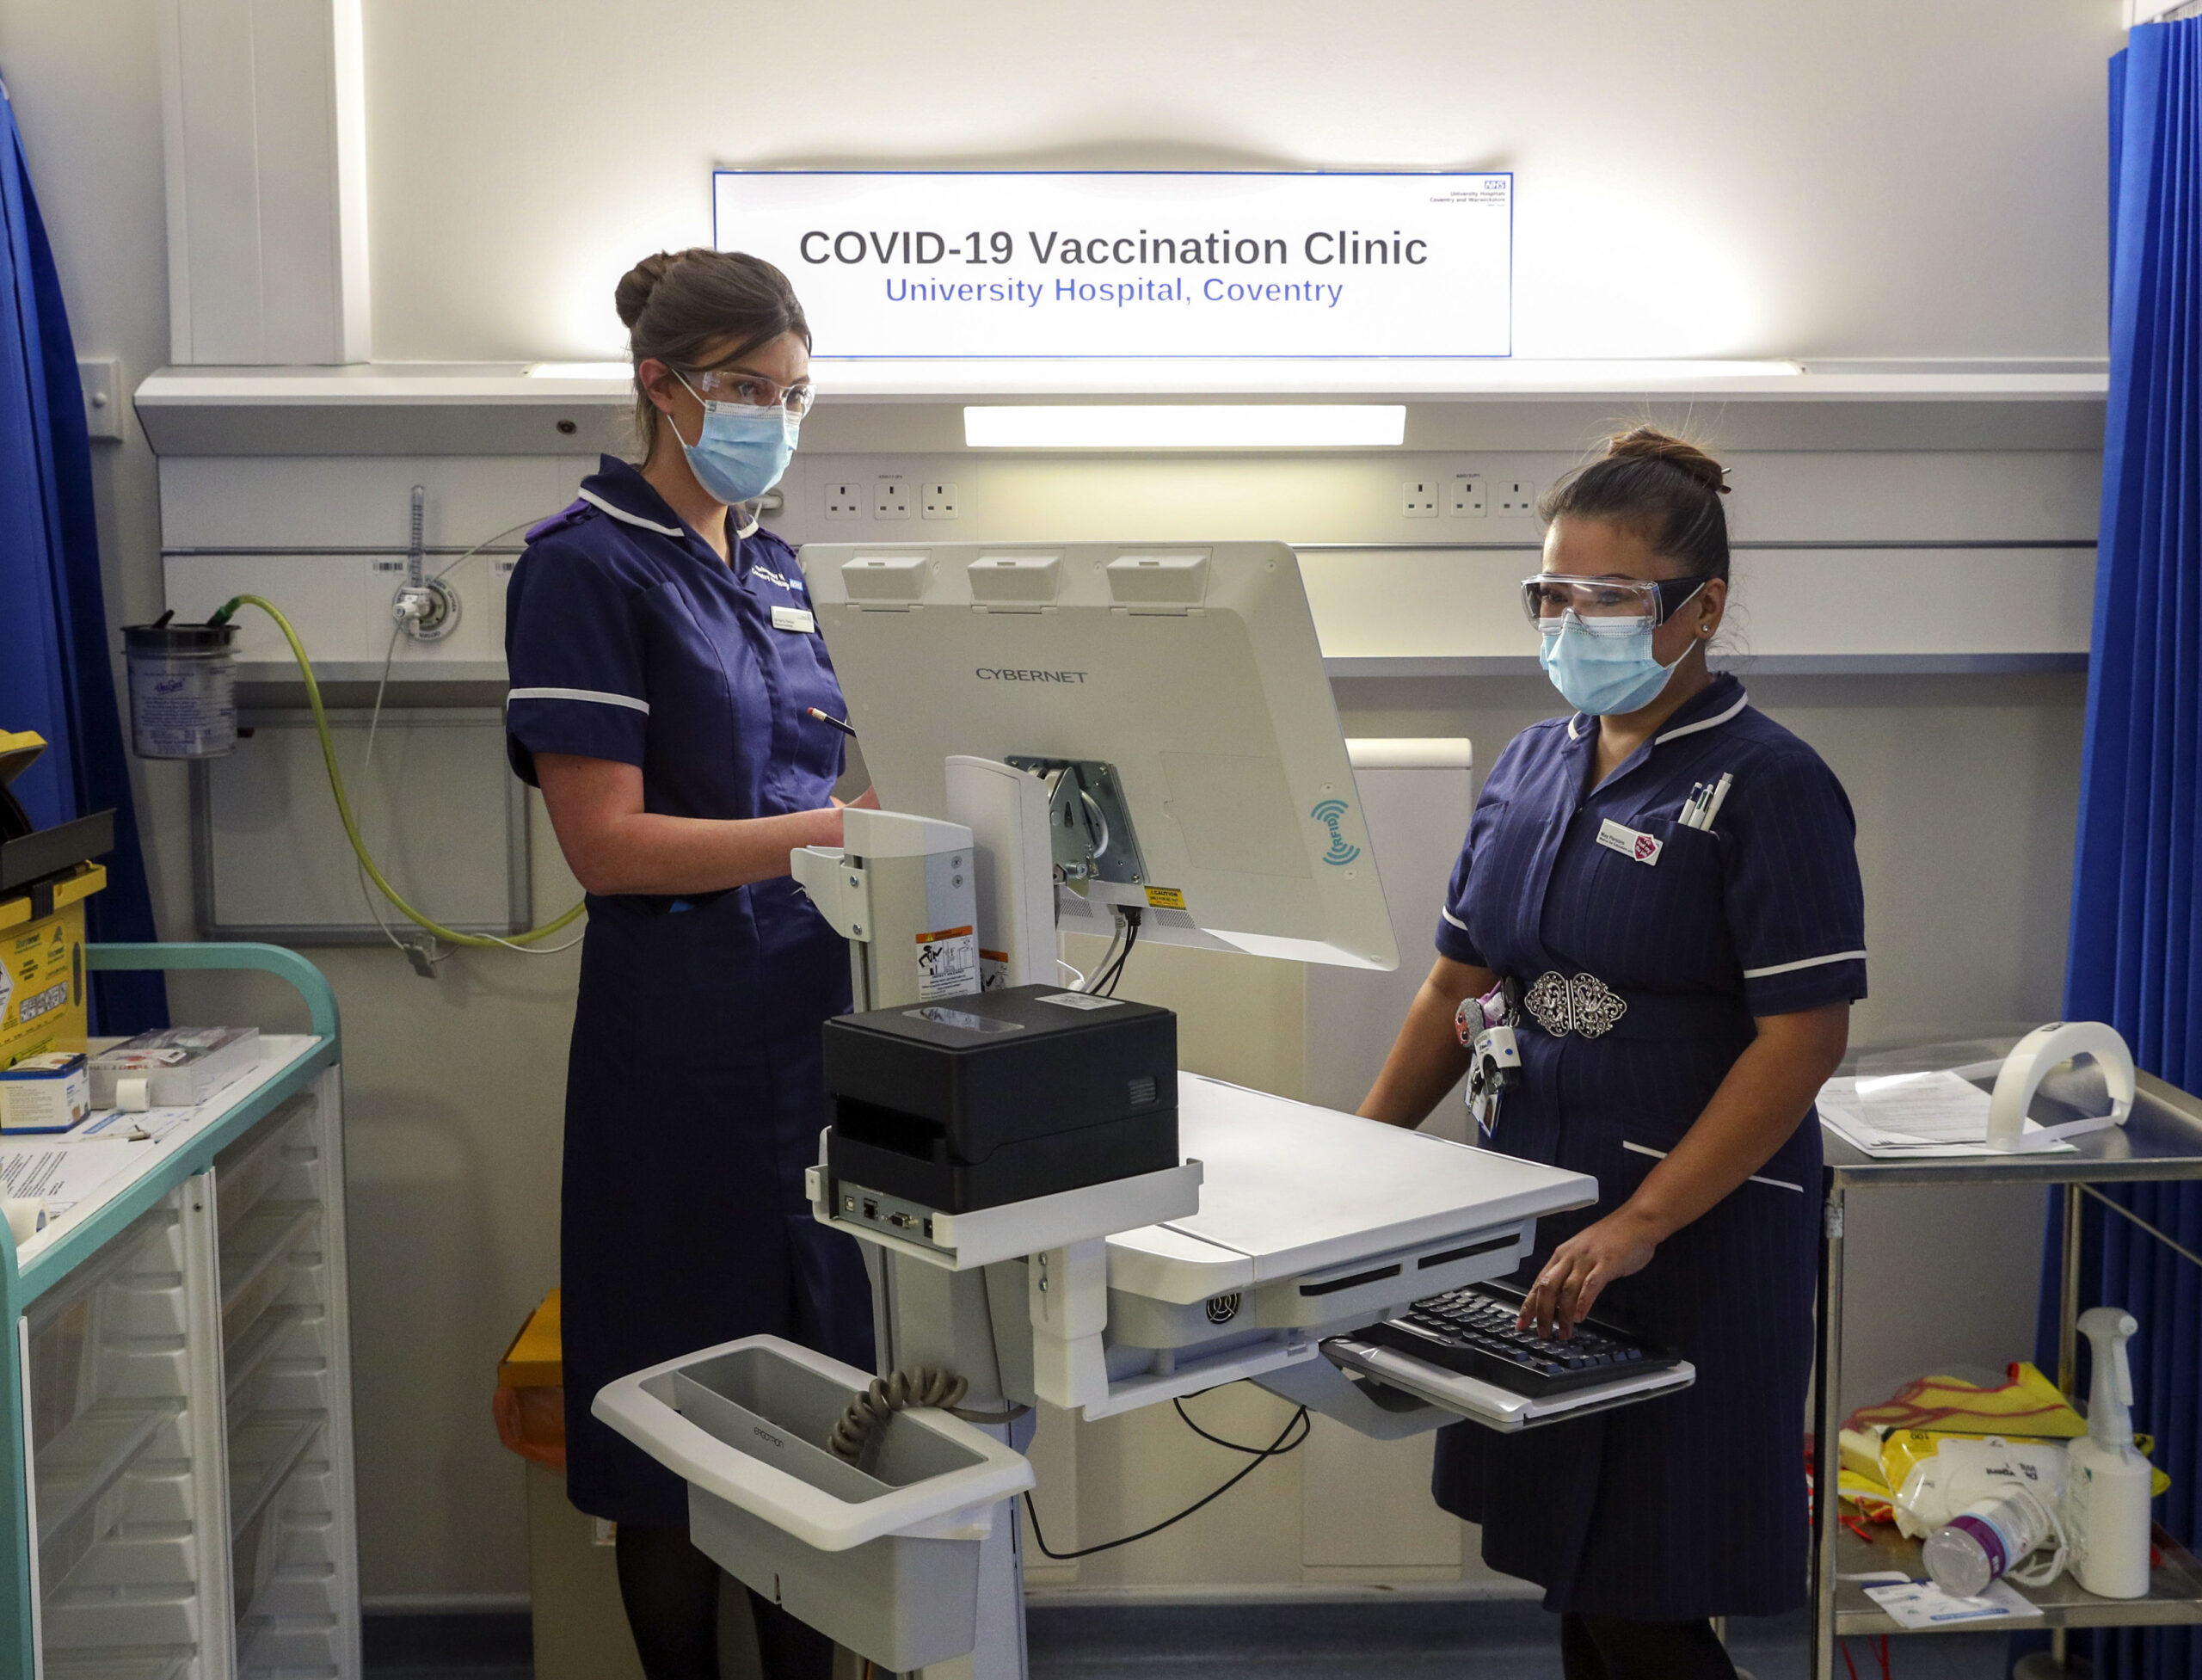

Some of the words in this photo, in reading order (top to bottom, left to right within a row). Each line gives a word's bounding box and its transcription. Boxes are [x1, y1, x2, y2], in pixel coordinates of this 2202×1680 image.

[1485, 181, 1506, 189] NHS
[800, 231, 1012, 264] COVID-19
[1029, 229, 1287, 264] Vaccination
[1304, 230, 1428, 264] Clinic
[886, 277, 1043, 308] University
[1055, 277, 1190, 308] Hospital,
[1203, 278, 1344, 308] Coventry
[975, 668, 1088, 683] CYBERNET
[1327, 818, 1344, 847] RFID
[753, 1426, 784, 1449] ERGOTRON
